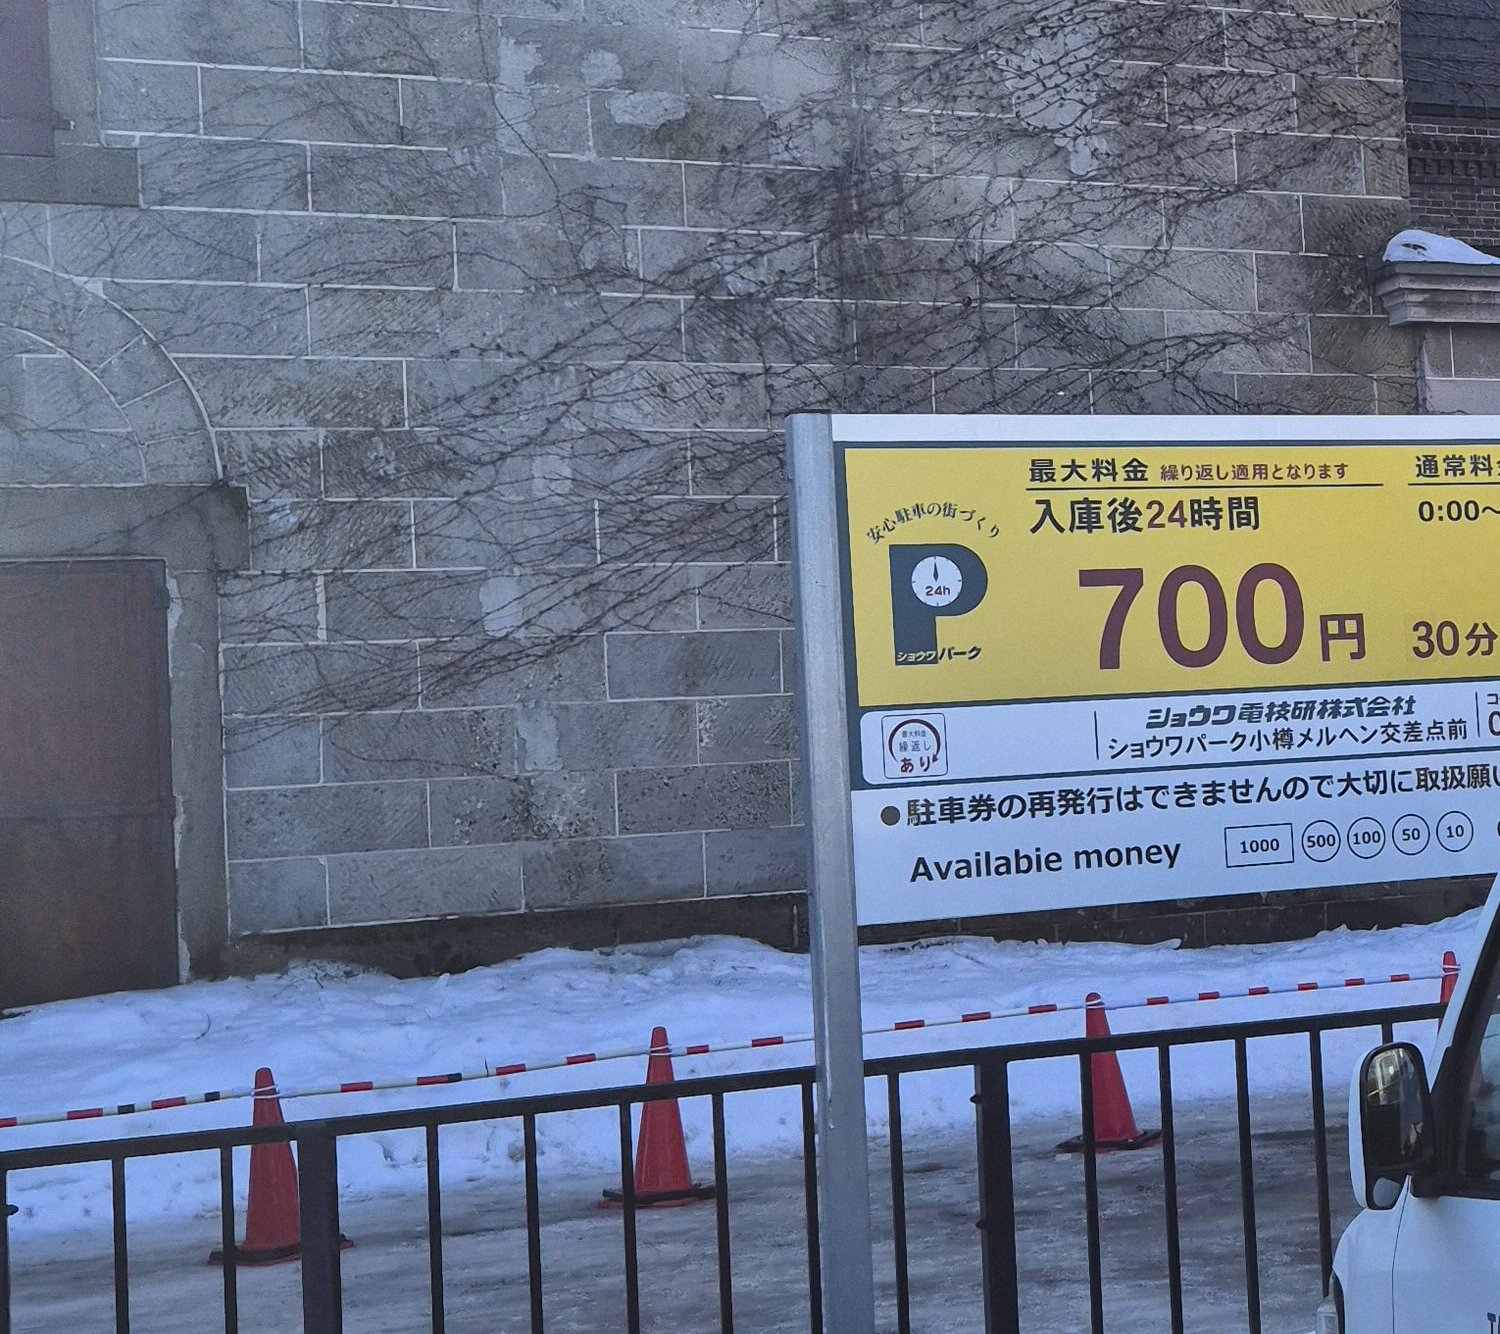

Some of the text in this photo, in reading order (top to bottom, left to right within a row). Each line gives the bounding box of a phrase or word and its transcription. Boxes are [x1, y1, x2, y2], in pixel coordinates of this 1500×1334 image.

[1028, 458, 1349, 484] 最大料金 繰り返し適用となります
[866, 501, 1000, 544] 安心駐車の街づくり
[1029, 496, 1261, 535] 入庫後24時間
[925, 585, 951, 597] 24h
[897, 645, 982, 663] ショウワパーク
[1412, 620, 1498, 659] 30分
[1145, 695, 1417, 730] ショウワ電技研株式会社
[1108, 718, 1468, 760] ショウワパーク小樽メルヘン交差点前
[900, 756, 931, 774] あり
[1239, 837, 1280, 854] 1000
[1306, 832, 1337, 848] 500
[1352, 830, 1382, 846] 100
[1401, 827, 1422, 842] 50
[1446, 823, 1464, 839] 10
[910, 842, 1181, 883] Availabie money
